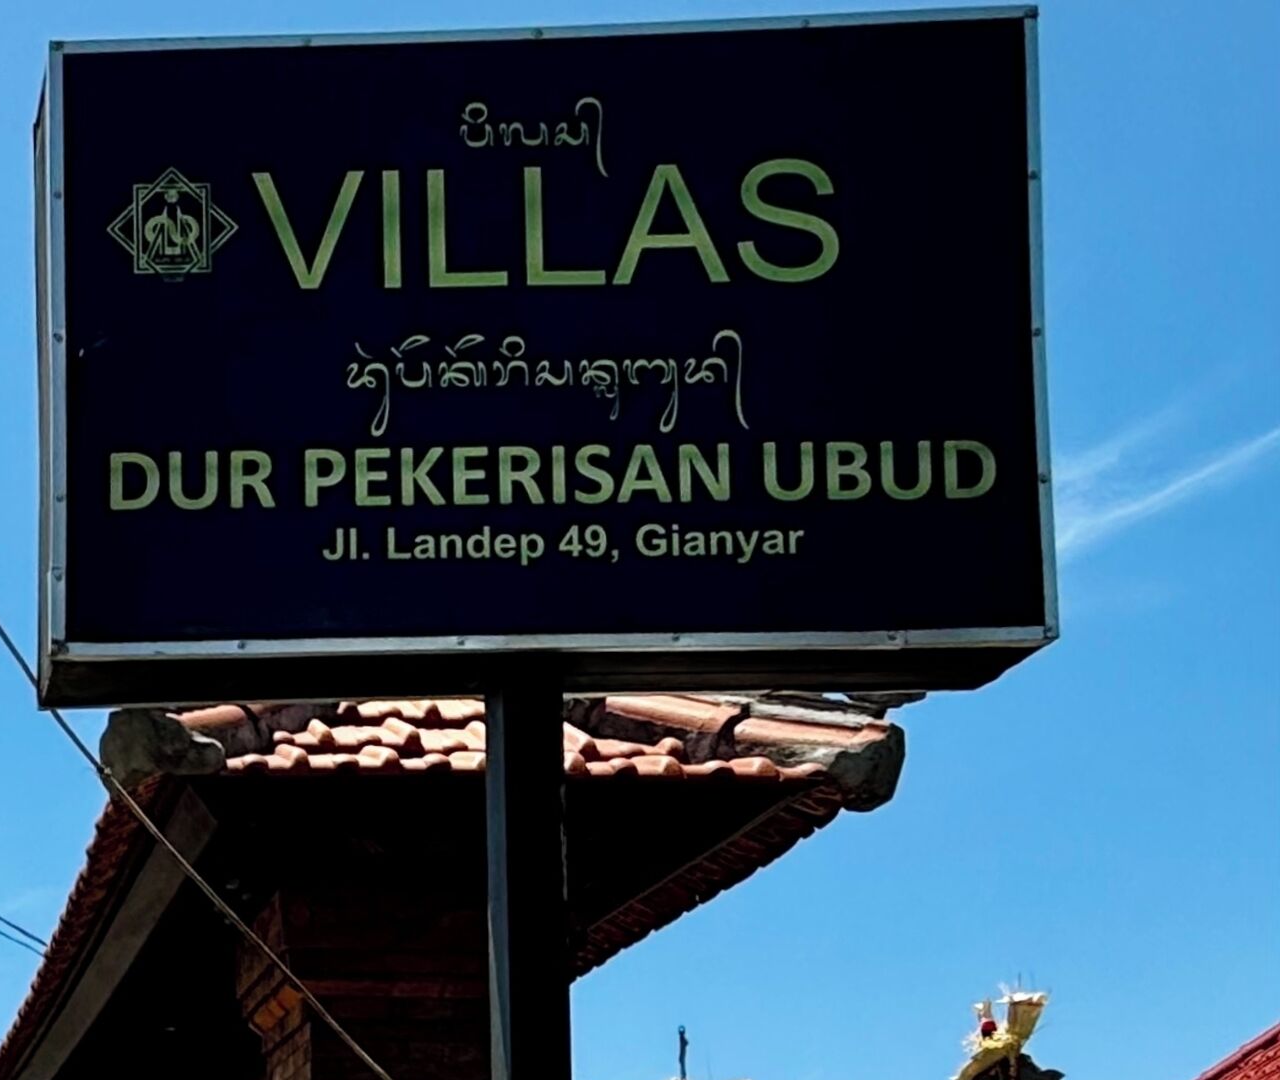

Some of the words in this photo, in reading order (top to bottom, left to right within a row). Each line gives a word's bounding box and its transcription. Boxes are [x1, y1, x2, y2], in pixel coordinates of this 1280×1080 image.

[251, 158, 840, 291] VILLAS
[109, 449, 276, 511] DUR
[304, 442, 731, 508] PEKERISAN
[762, 439, 997, 503] UBUD
[322, 527, 370, 561] Jl.
[386, 525, 545, 566] Landep
[558, 524, 619, 563] 49,
[635, 523, 805, 564] Gianyar
